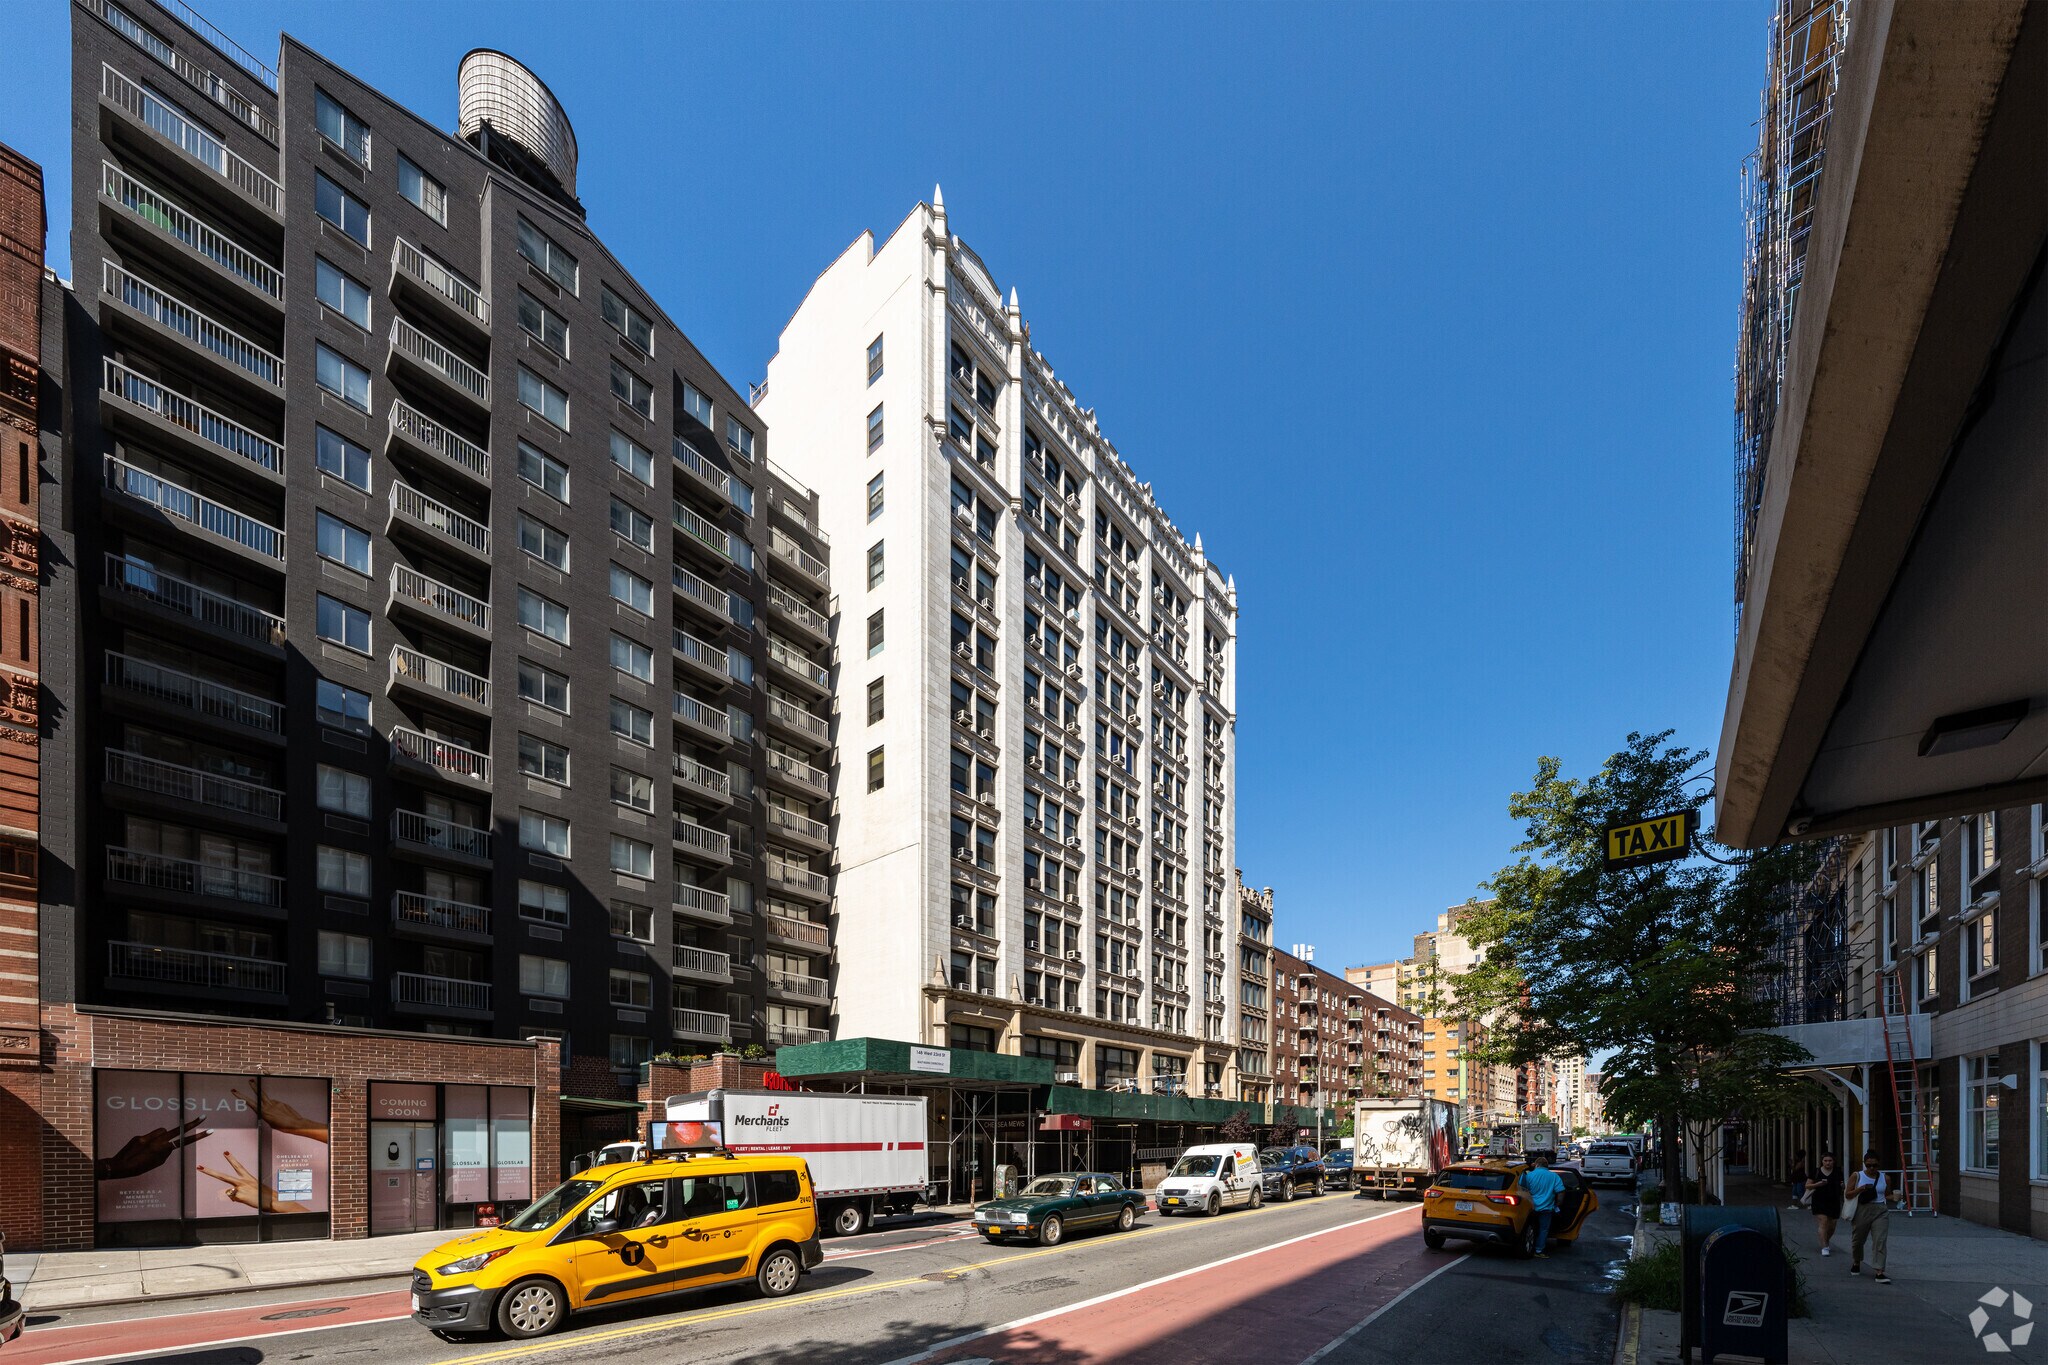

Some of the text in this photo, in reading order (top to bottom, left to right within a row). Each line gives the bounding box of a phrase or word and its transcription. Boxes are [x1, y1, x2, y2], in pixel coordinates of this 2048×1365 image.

[1614, 819, 1677, 857] TAXI
[106, 1096, 248, 1112] GLOSSLAB
[380, 1099, 427, 1107] COMING
[734, 1114, 790, 1126] Merchants
[626, 1244, 640, 1263] T
